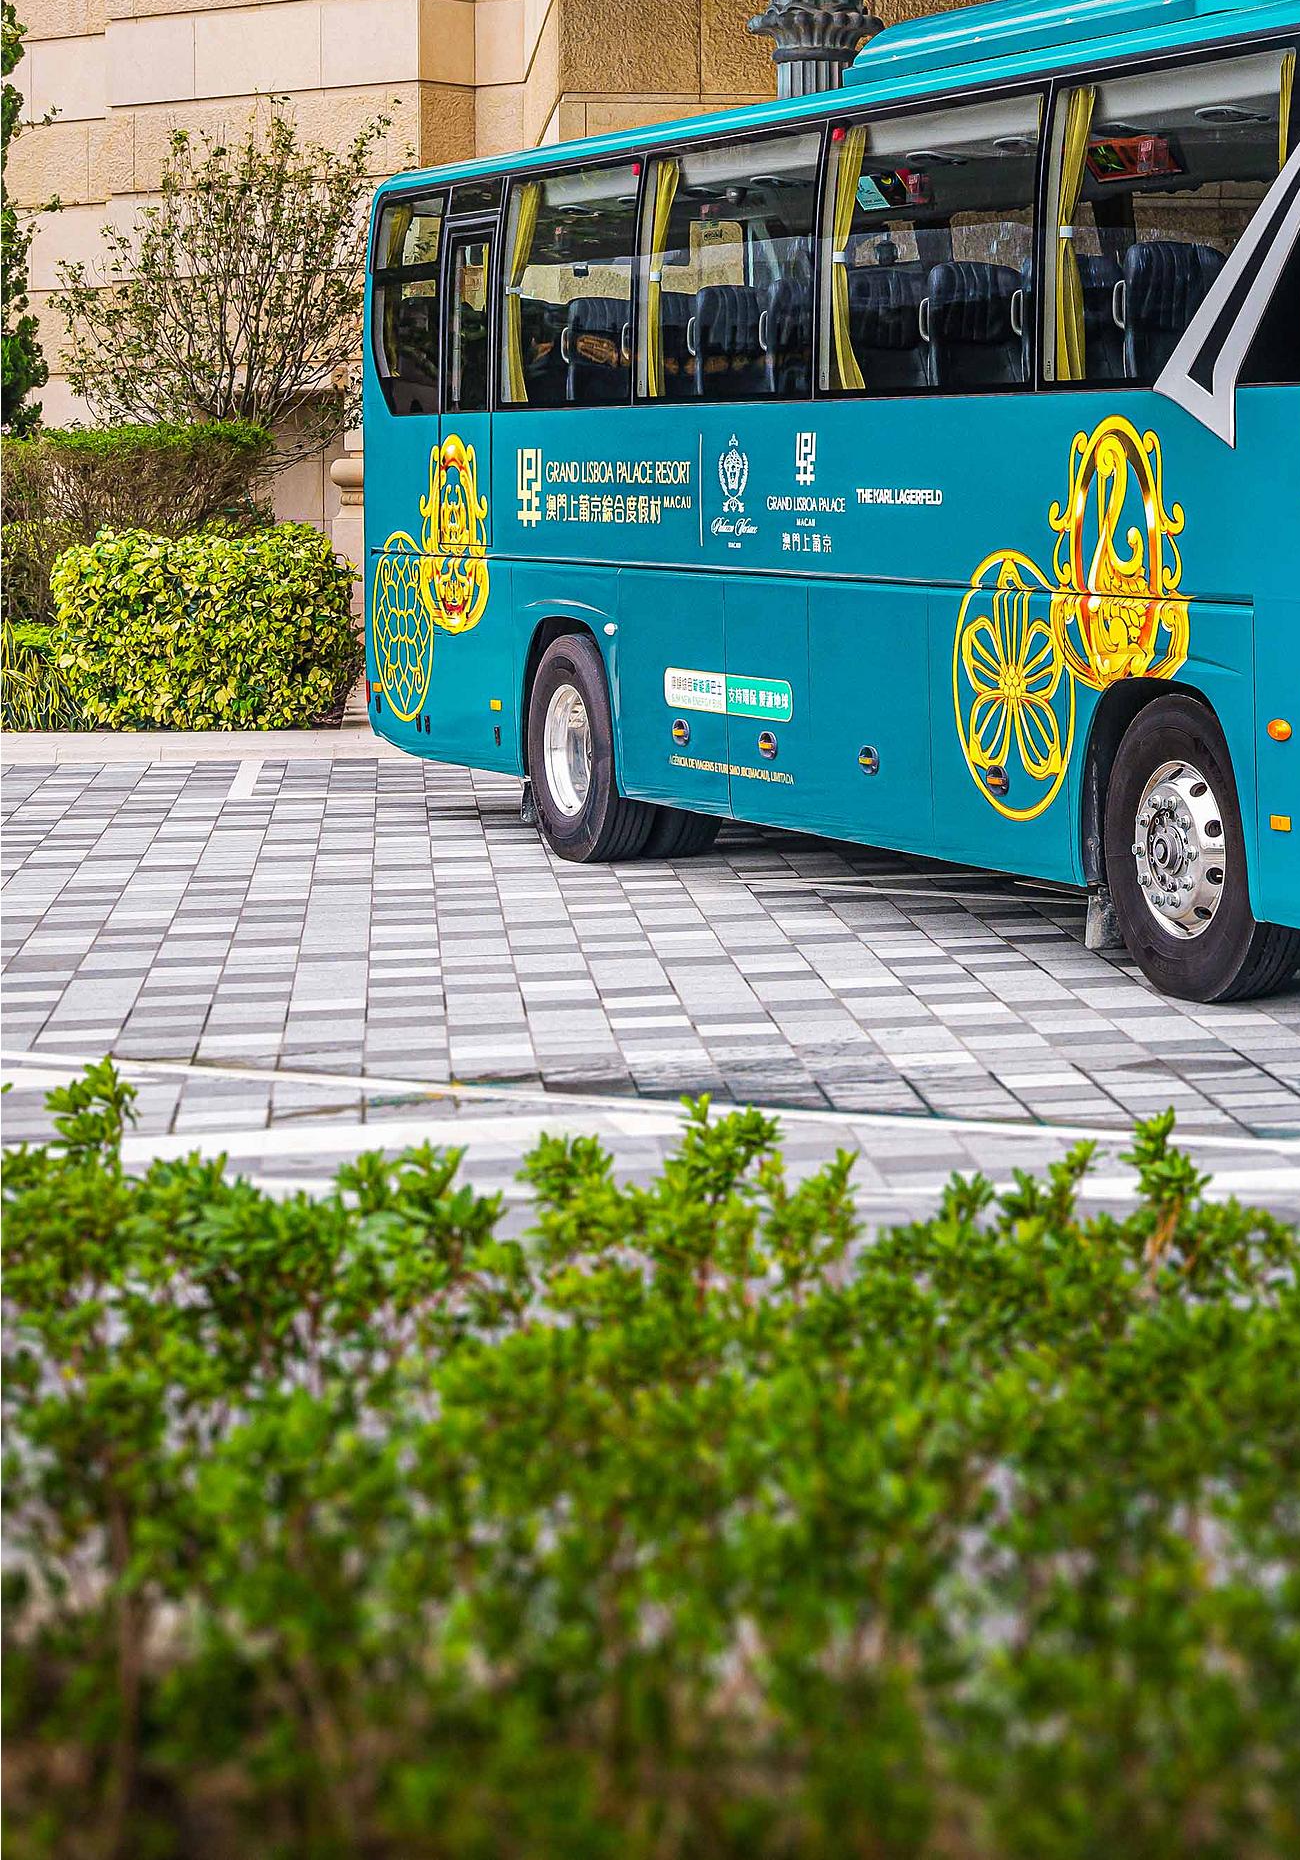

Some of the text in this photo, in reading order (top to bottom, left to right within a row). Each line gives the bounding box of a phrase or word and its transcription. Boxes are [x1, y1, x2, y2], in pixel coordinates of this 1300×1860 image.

[546, 460, 690, 484] GRAND LISBOA PALACE RESORT
[663, 496, 692, 509] MACAU
[767, 496, 846, 513] GRAND LISBOA PALACE
[856, 488, 942, 506] THE KARL LAGERFELD
